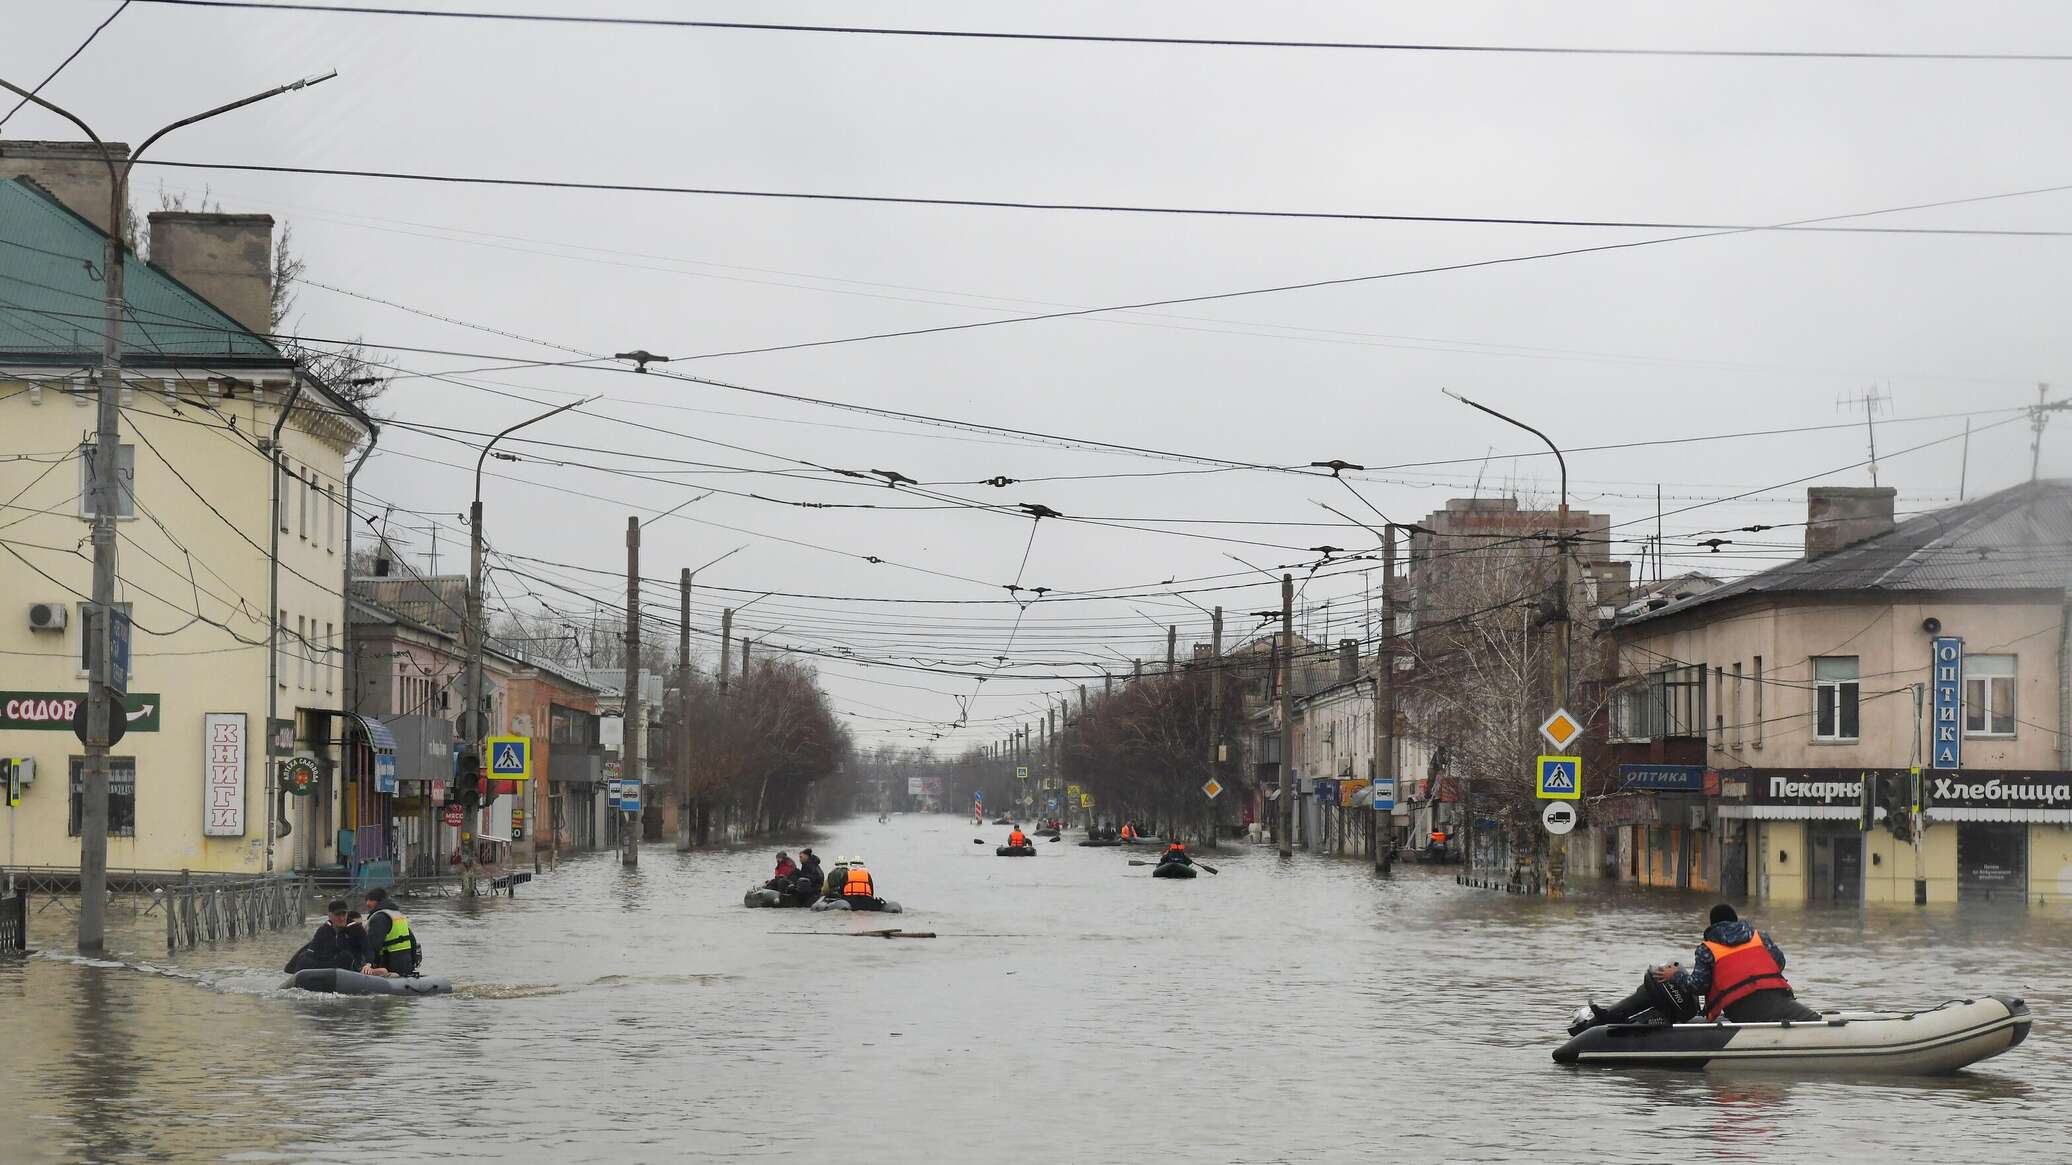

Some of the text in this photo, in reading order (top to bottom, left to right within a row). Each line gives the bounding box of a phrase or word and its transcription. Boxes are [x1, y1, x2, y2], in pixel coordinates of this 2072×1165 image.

[1939, 646, 1956, 761] ОПТИКА
[212, 724, 238, 827] КНИГИ
[1626, 771, 1688, 782] ОПТИКА
[1769, 776, 1863, 804] Пекарня
[1933, 778, 2071, 805] Хлебница
